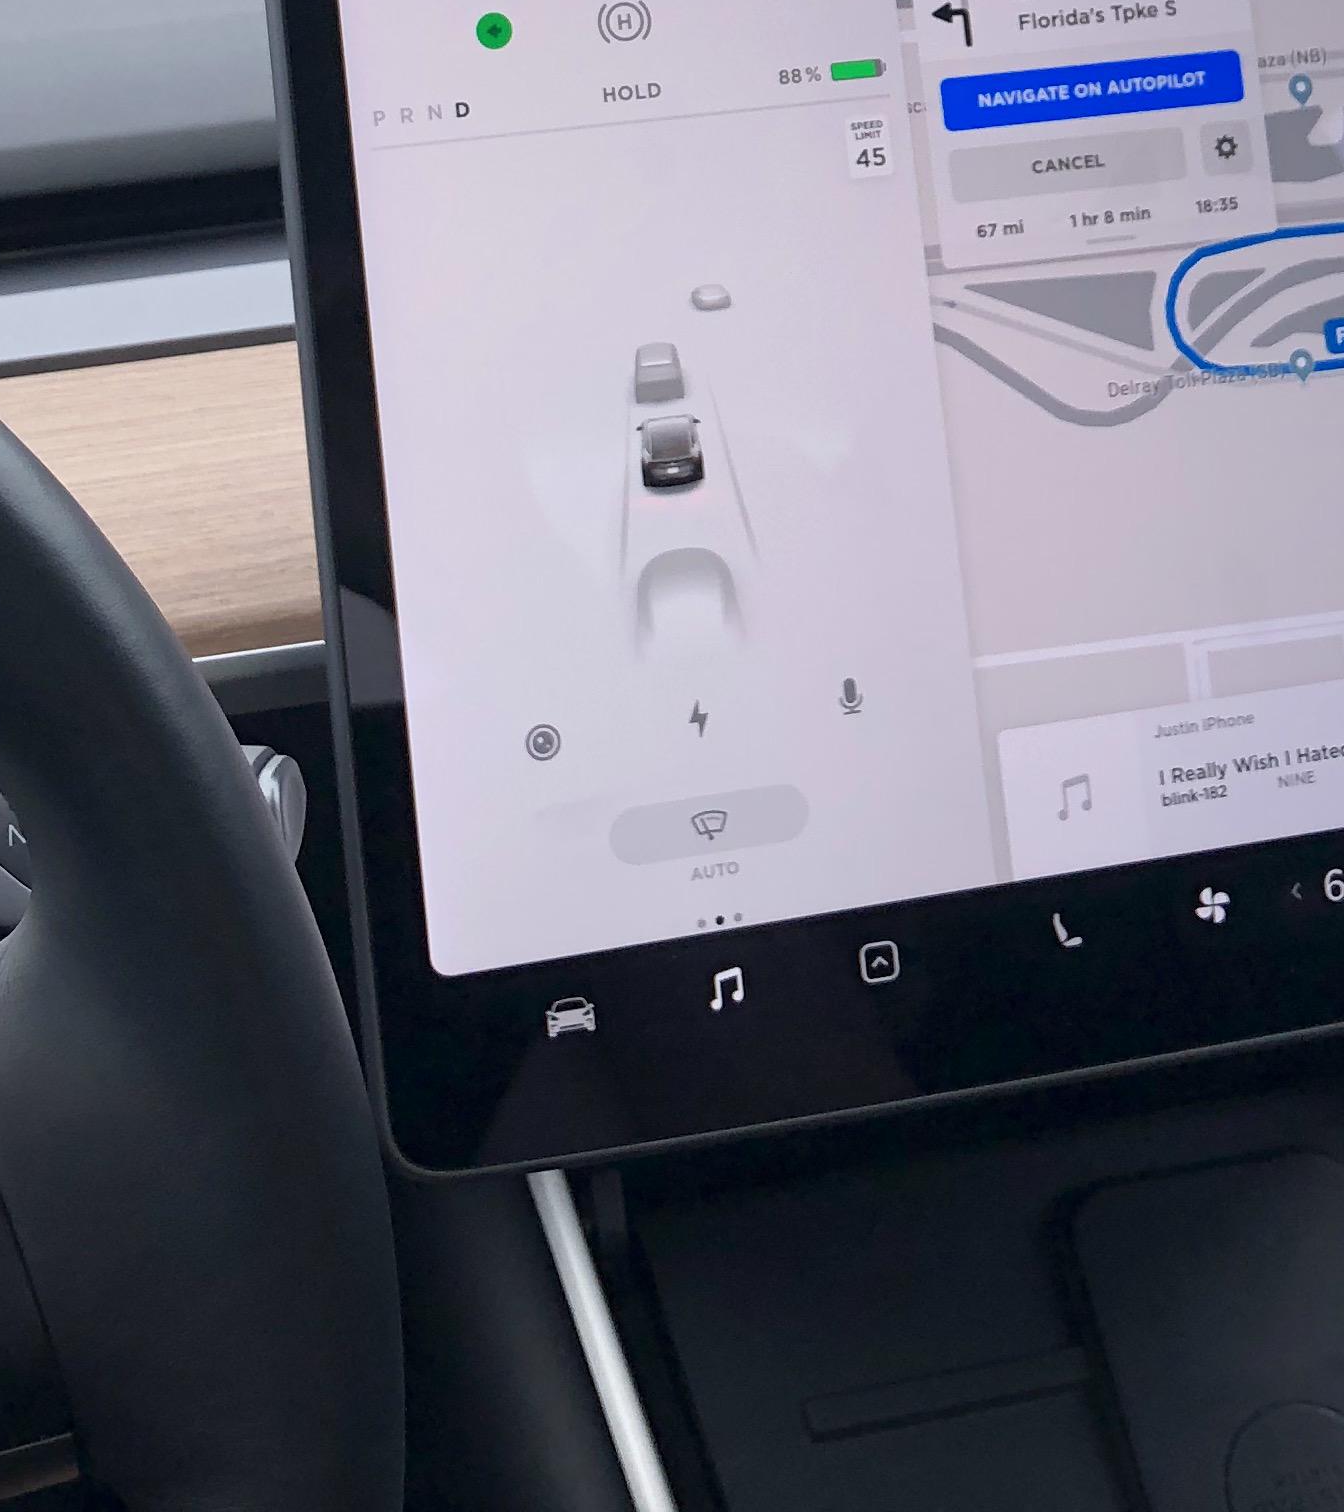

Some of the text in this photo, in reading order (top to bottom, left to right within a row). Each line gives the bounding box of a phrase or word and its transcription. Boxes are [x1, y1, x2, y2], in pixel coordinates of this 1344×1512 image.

[1018, 0, 1177, 30] Florida's Tpke S
[1290, 47, 1327, 68] (NB)
[779, 66, 822, 85] 88%
[603, 82, 662, 103] HOLD
[977, 70, 1206, 108] NAVIGATE ON AUTOPILOT
[373, 101, 470, 127] P R N D
[850, 119, 883, 131] SPEED
[855, 130, 882, 141] LIMIT
[856, 147, 887, 167] 45
[1032, 154, 1105, 174] CANCEL
[1195, 196, 1239, 214] 18:35
[1069, 206, 1151, 228] 1 hr 8 min
[977, 219, 1025, 239] 67 mi
[1107, 377, 1160, 398] Delray
[1154, 712, 1255, 739] Justin iPhone
[1159, 769, 1166, 786] I
[1171, 761, 1227, 784] Really
[1232, 750, 1280, 775] Wish
[1284, 749, 1292, 766] I
[1277, 770, 1317, 789] NINE
[1160, 784, 1228, 808] blink-182
[690, 861, 739, 881] AUTO
